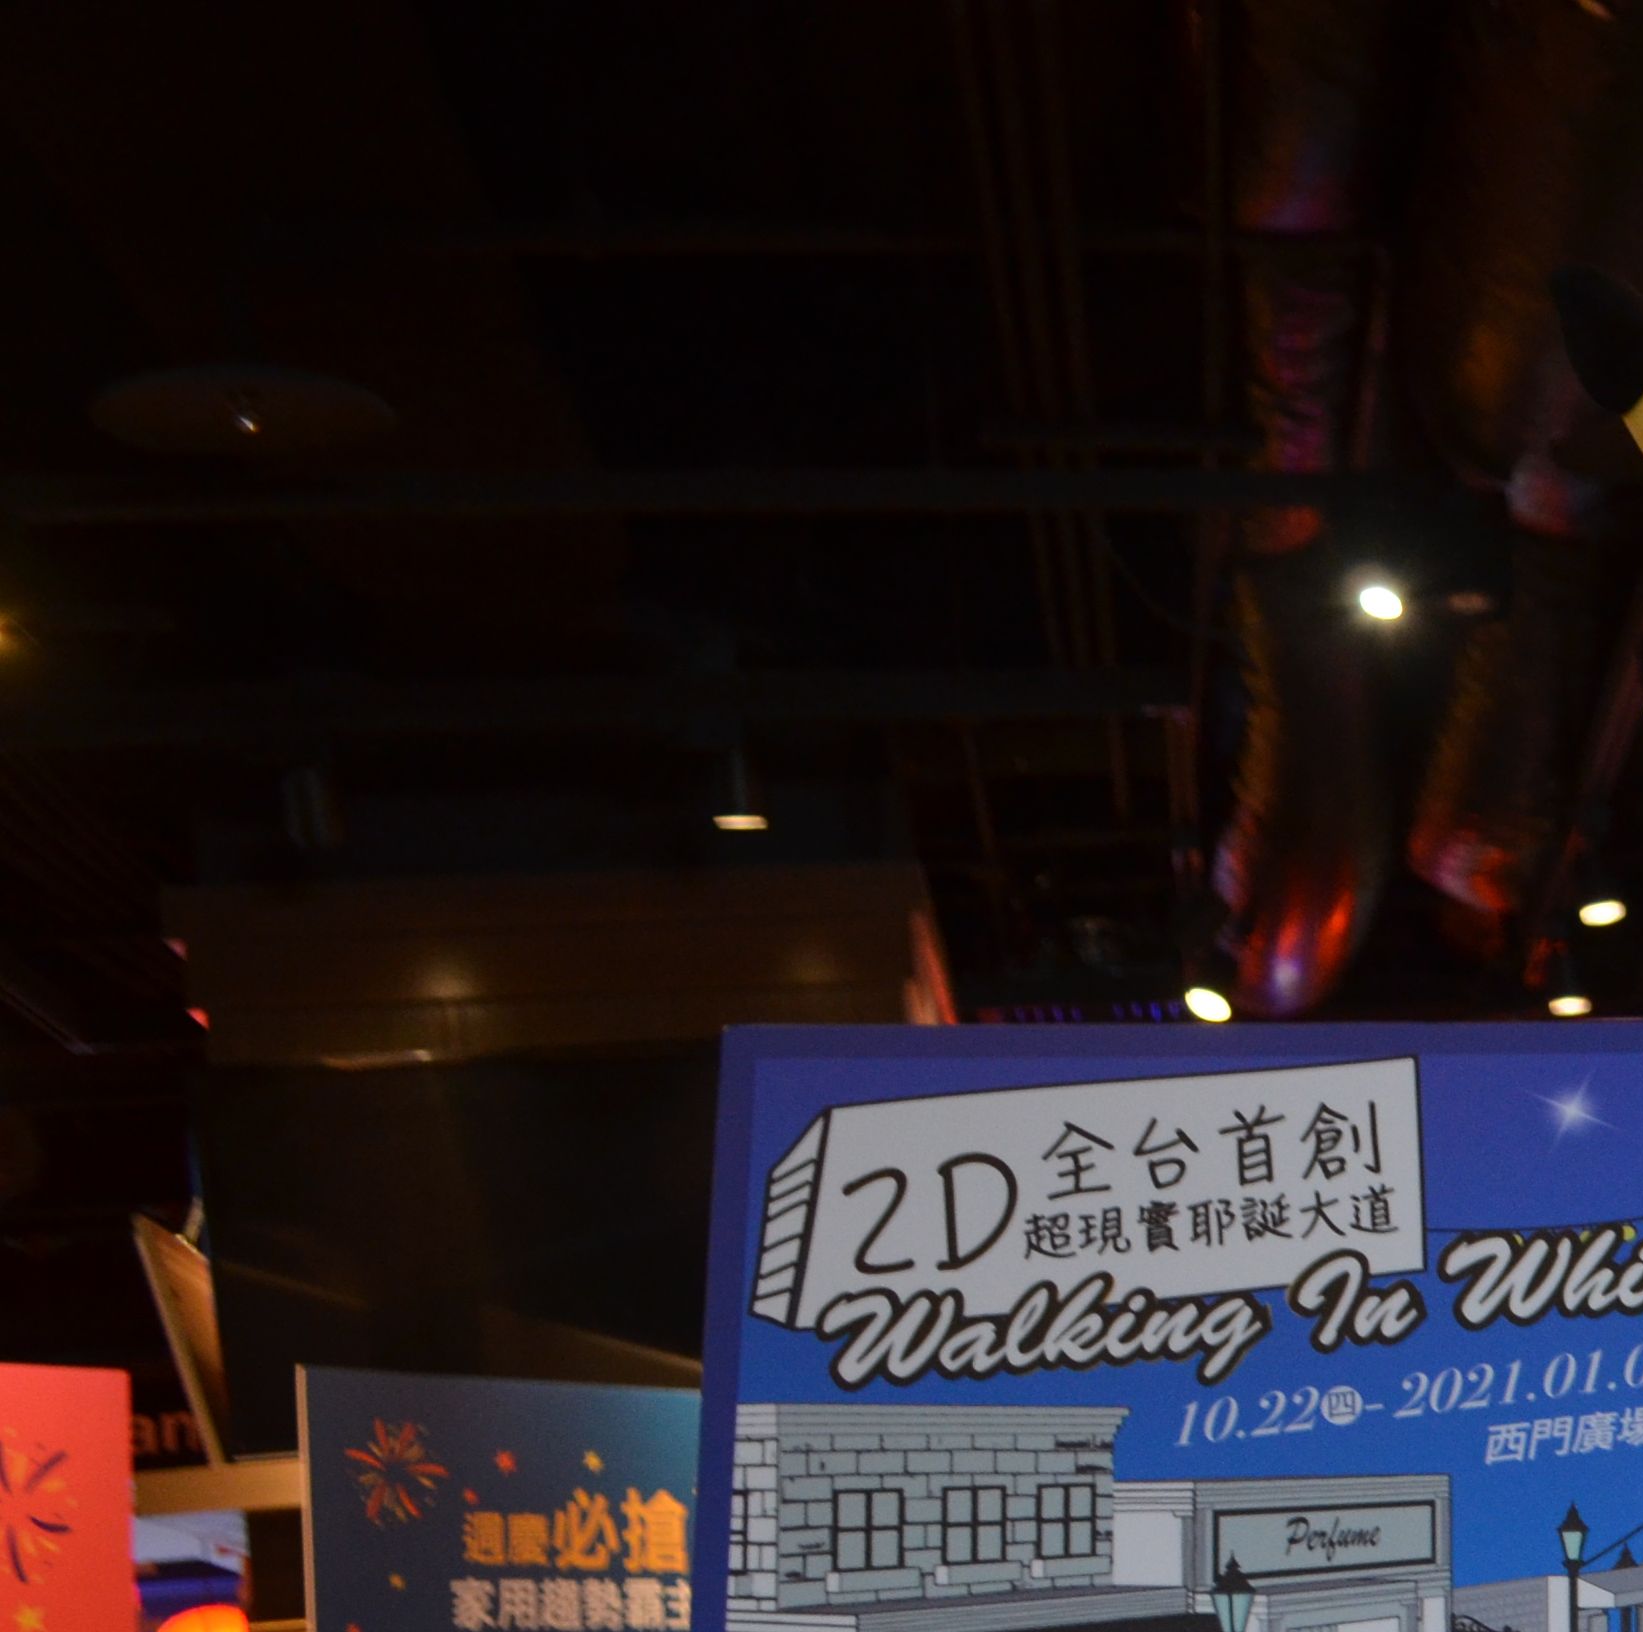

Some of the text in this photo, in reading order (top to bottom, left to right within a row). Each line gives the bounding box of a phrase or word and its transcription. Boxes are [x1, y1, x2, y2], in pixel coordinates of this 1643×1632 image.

[1042, 1101, 1381, 1200] 全台首創
[842, 1152, 1018, 1274] 2D
[1025, 1186, 1399, 1259] 超現實耶誕大道
[817, 1274, 1268, 1385] Walking
[1290, 1250, 1426, 1352] In
[1285, 1516, 1381, 1562] Perfume
